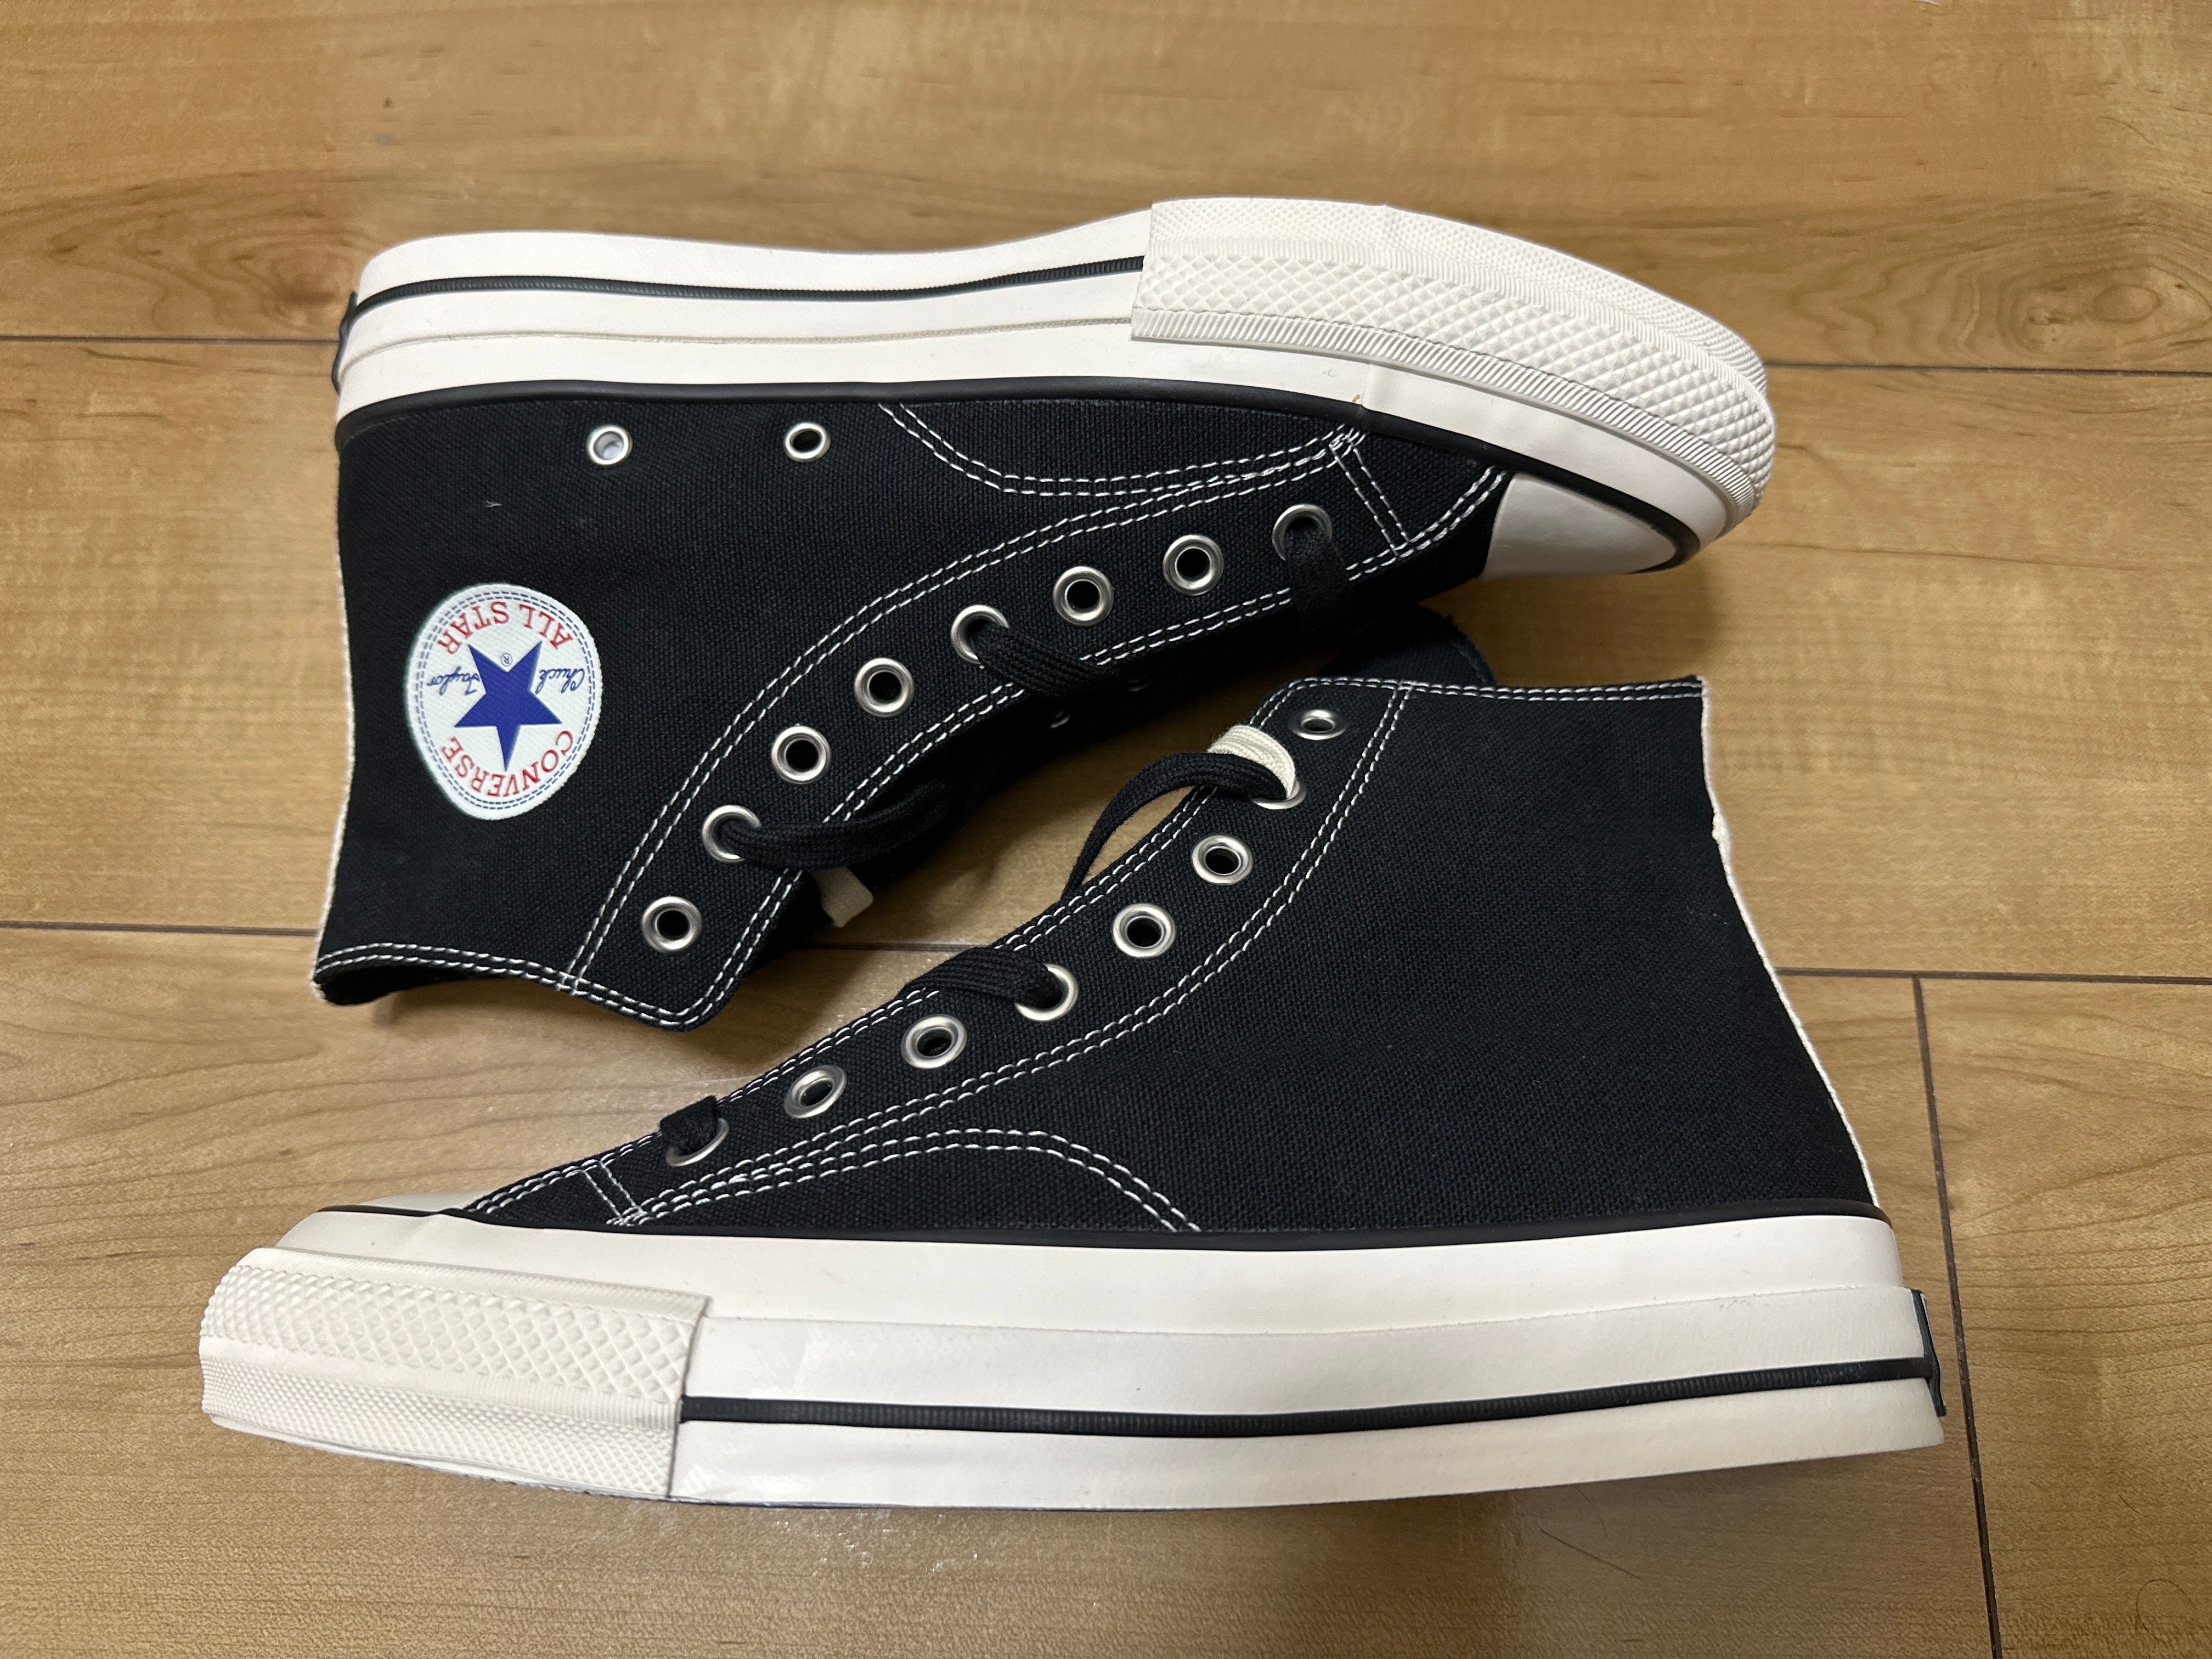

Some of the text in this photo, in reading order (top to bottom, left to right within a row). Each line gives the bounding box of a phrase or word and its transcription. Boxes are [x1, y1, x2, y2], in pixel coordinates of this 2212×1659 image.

[436, 601, 574, 655] ALL STAR
[427, 665, 585, 696] Chuck Taylor
[441, 730, 574, 798] CONVERSE
